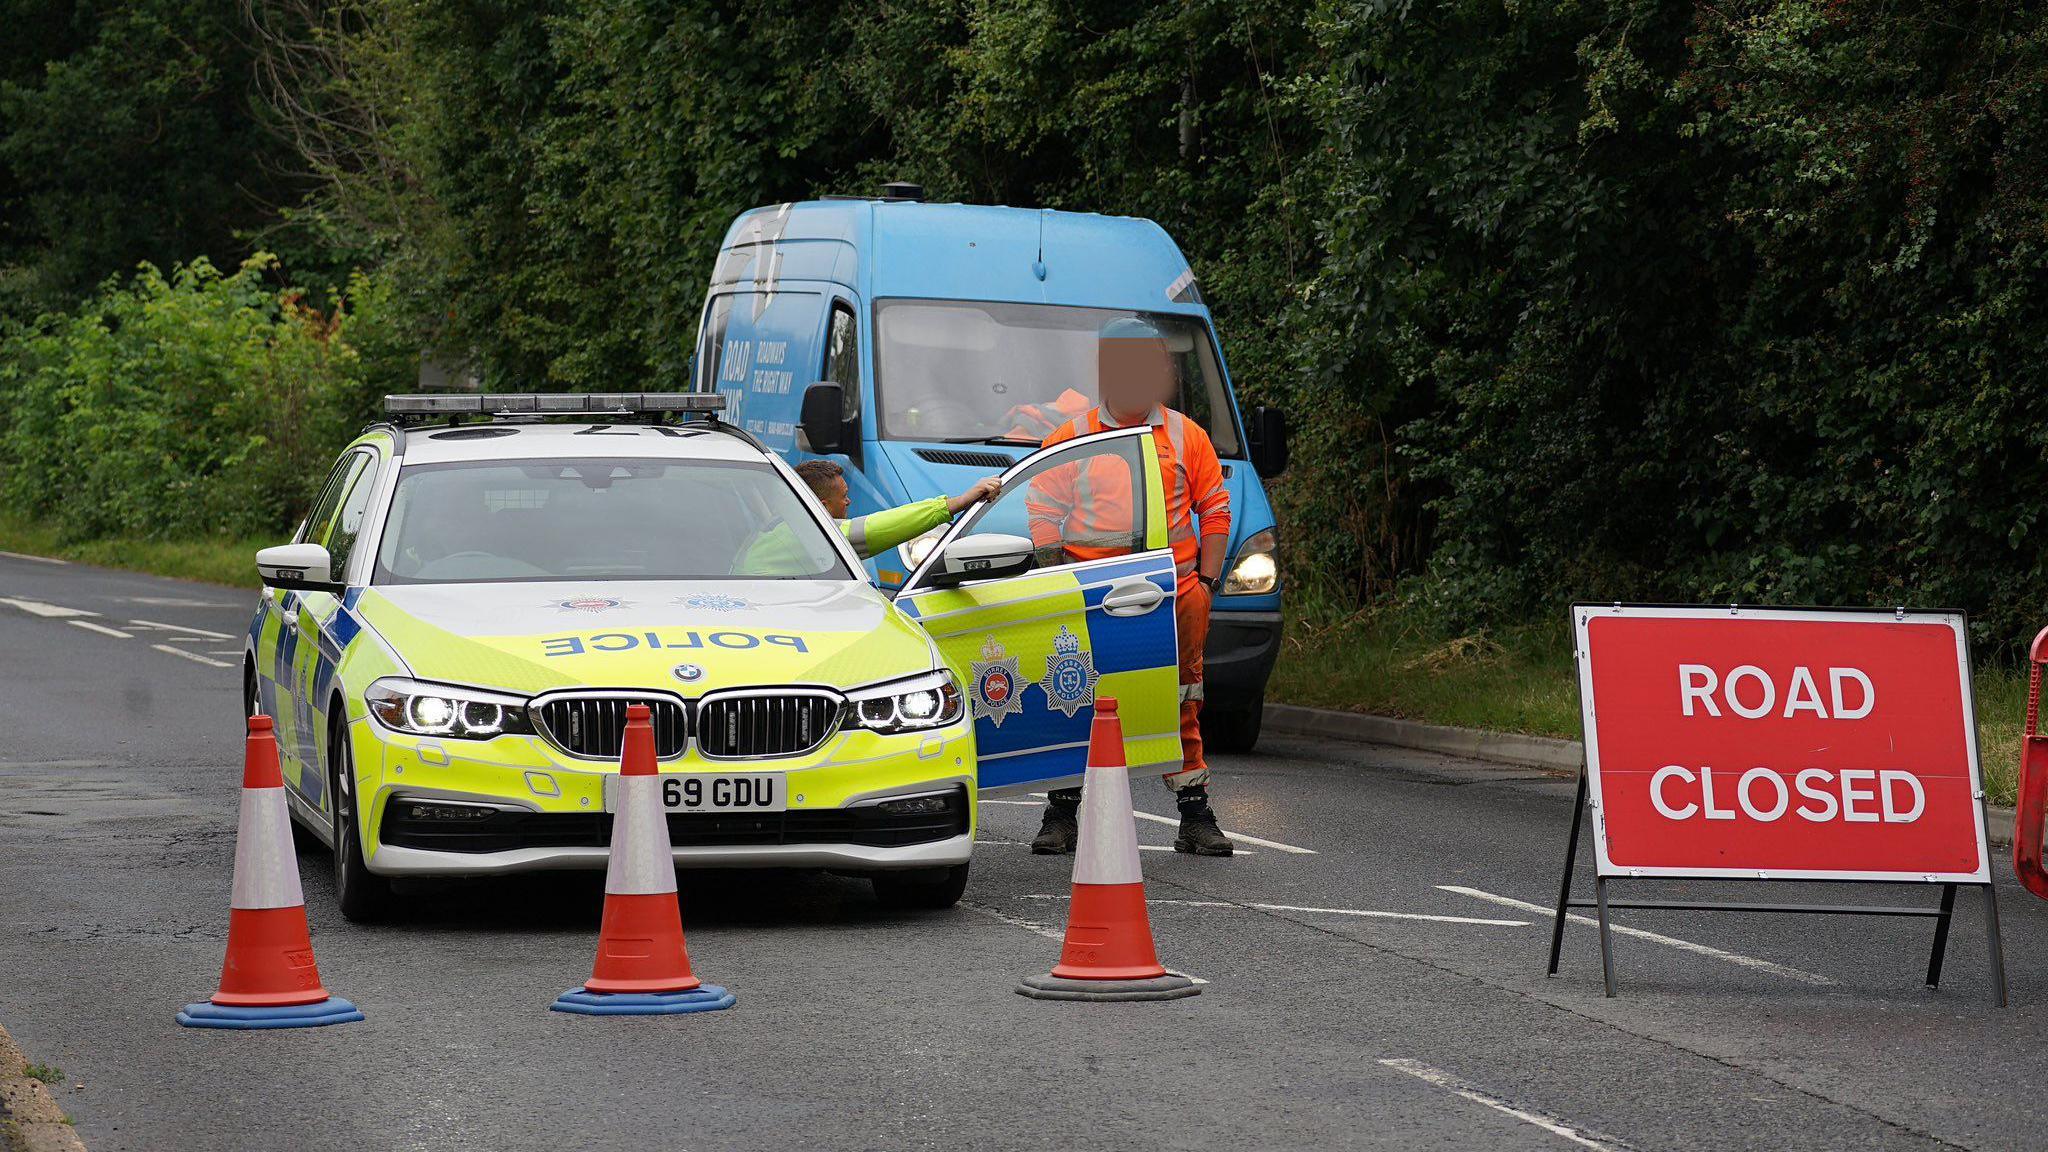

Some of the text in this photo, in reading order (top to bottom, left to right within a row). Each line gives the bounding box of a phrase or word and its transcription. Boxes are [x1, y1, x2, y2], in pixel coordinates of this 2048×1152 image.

[723, 340, 750, 381] ROAD
[757, 340, 786, 364] ROADWAYS
[752, 369, 793, 394] THE RIGHT WAY
[984, 666, 1008, 678] SURREY
[987, 696, 1009, 707] POLICE
[1057, 686, 1084, 700] POLICE
[1679, 664, 1875, 720] ROAD
[662, 778, 773, 807] 69 GDU
[1649, 765, 1926, 823] CLOSED
